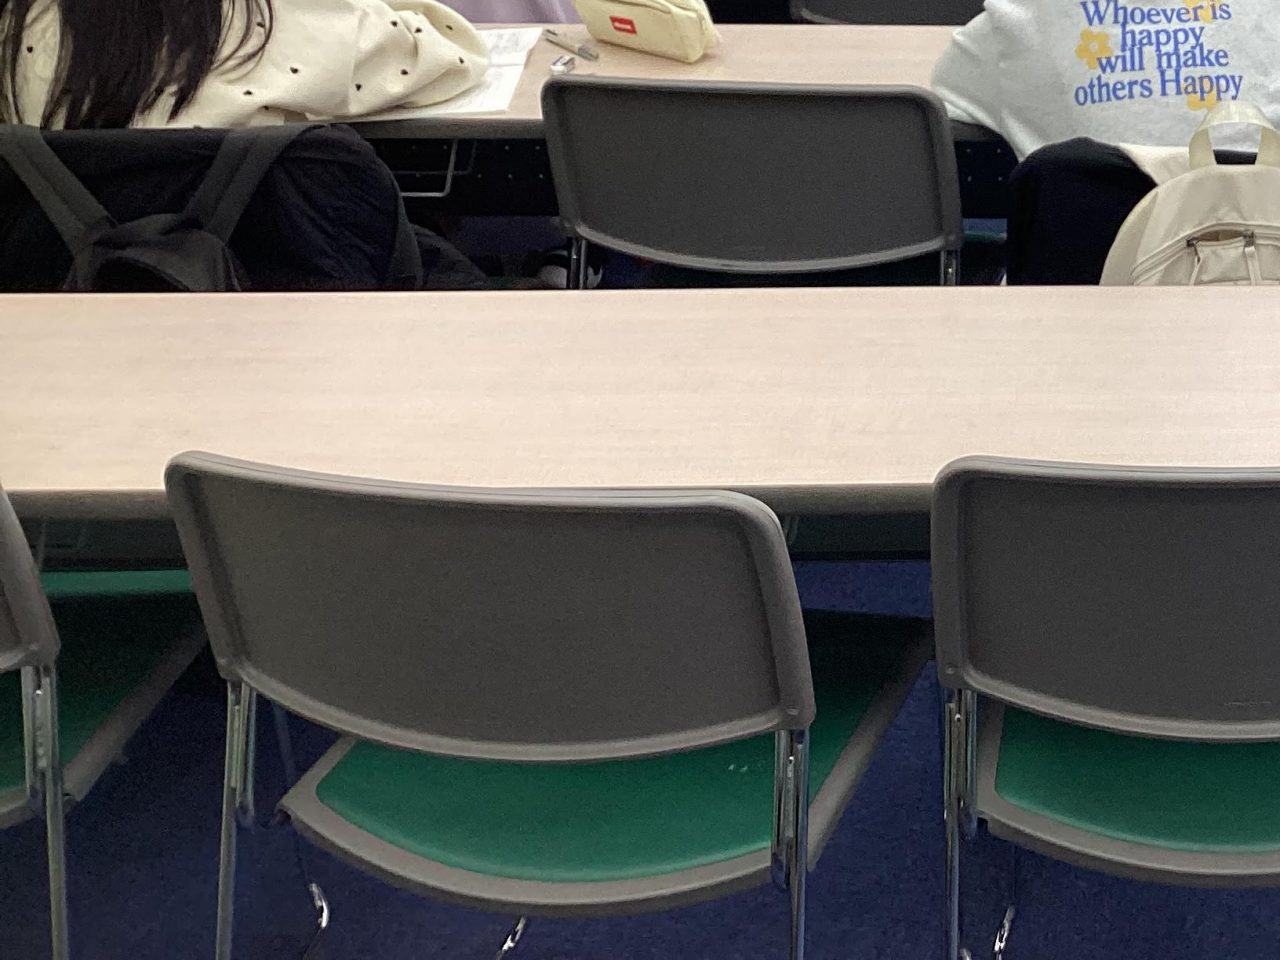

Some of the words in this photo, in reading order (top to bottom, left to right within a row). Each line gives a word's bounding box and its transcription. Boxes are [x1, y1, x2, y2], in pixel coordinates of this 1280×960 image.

[1121, 23, 1205, 52] happy
[1097, 46, 1145, 74] will
[1156, 44, 1229, 70] make
[1074, 75, 1153, 106] others
[1160, 69, 1243, 101] Happy
